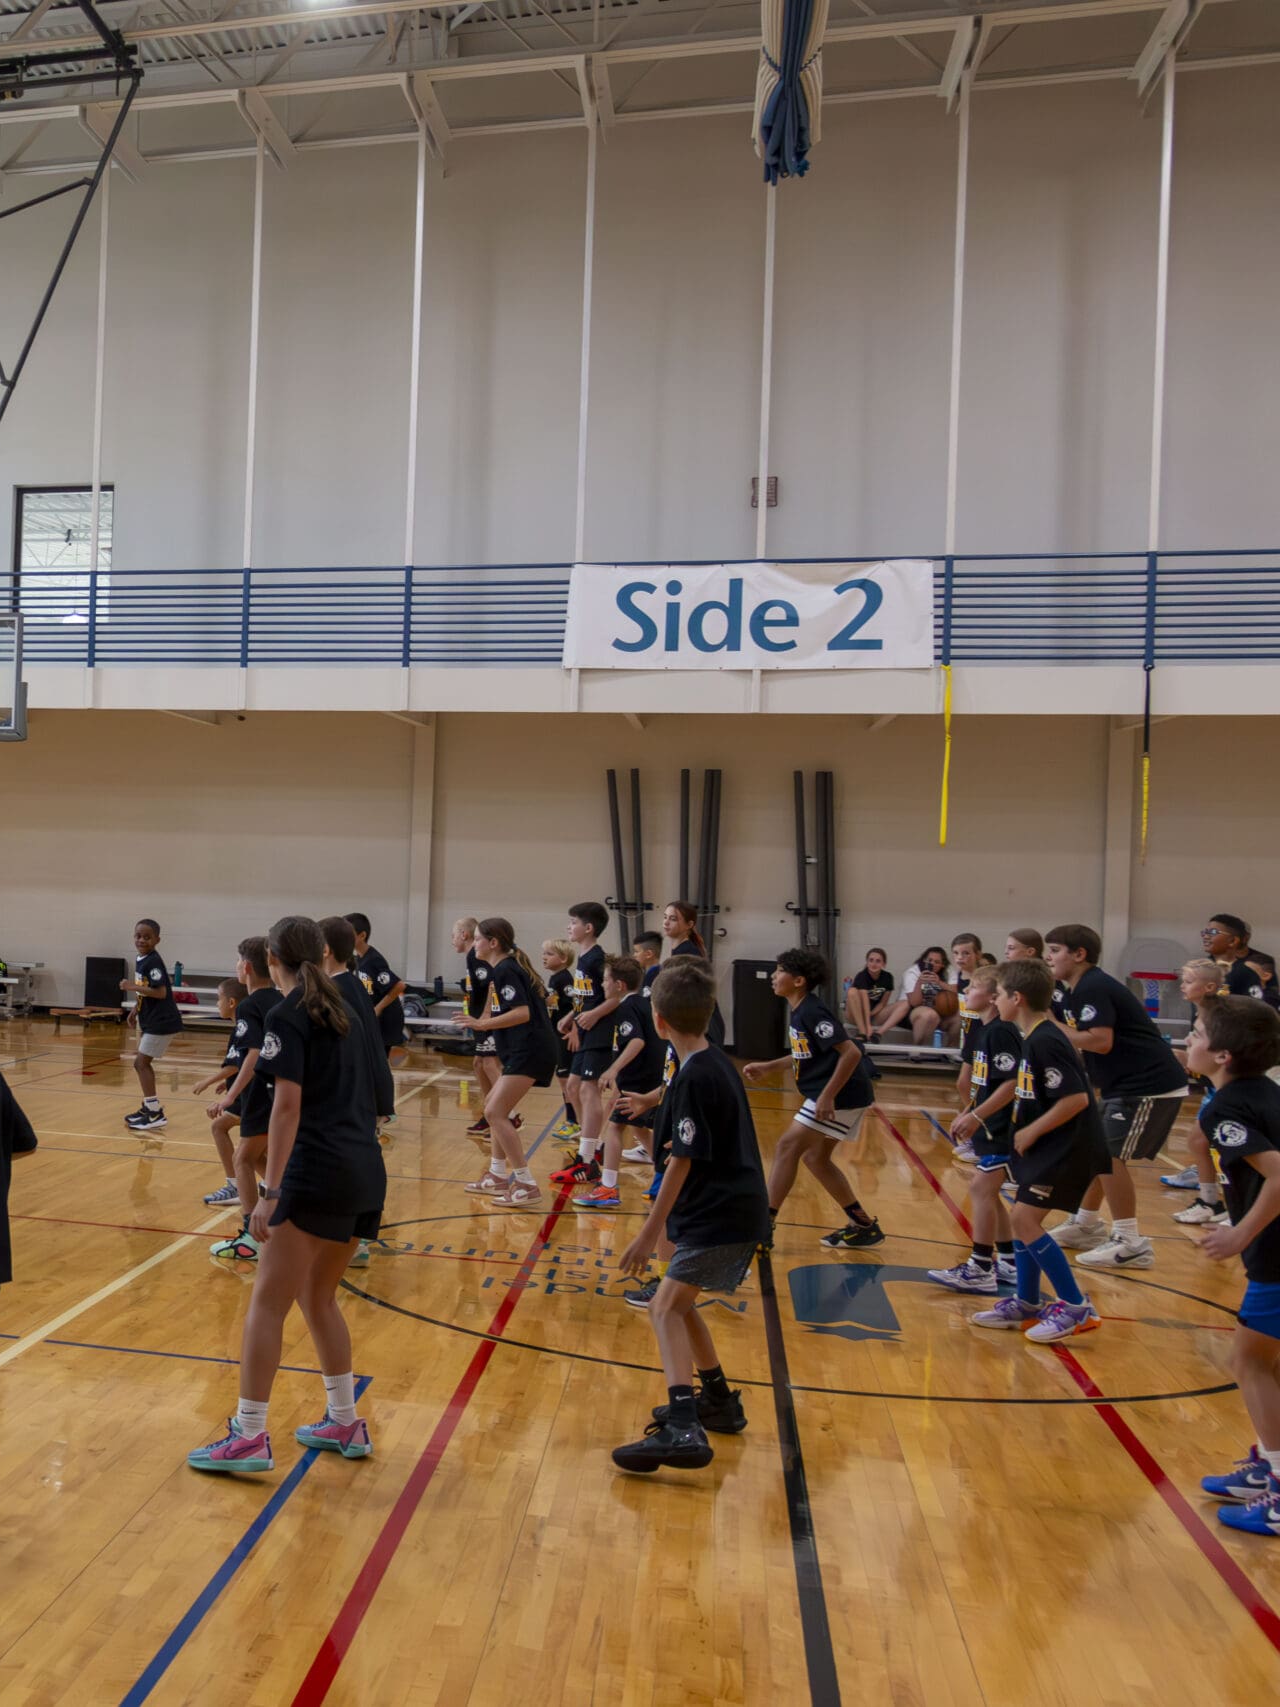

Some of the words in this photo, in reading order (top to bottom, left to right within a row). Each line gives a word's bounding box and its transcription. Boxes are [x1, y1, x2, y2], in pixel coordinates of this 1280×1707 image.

[612, 578, 800, 653] Side
[827, 578, 883, 650] 2
[481, 1276, 748, 1313] Mndel
